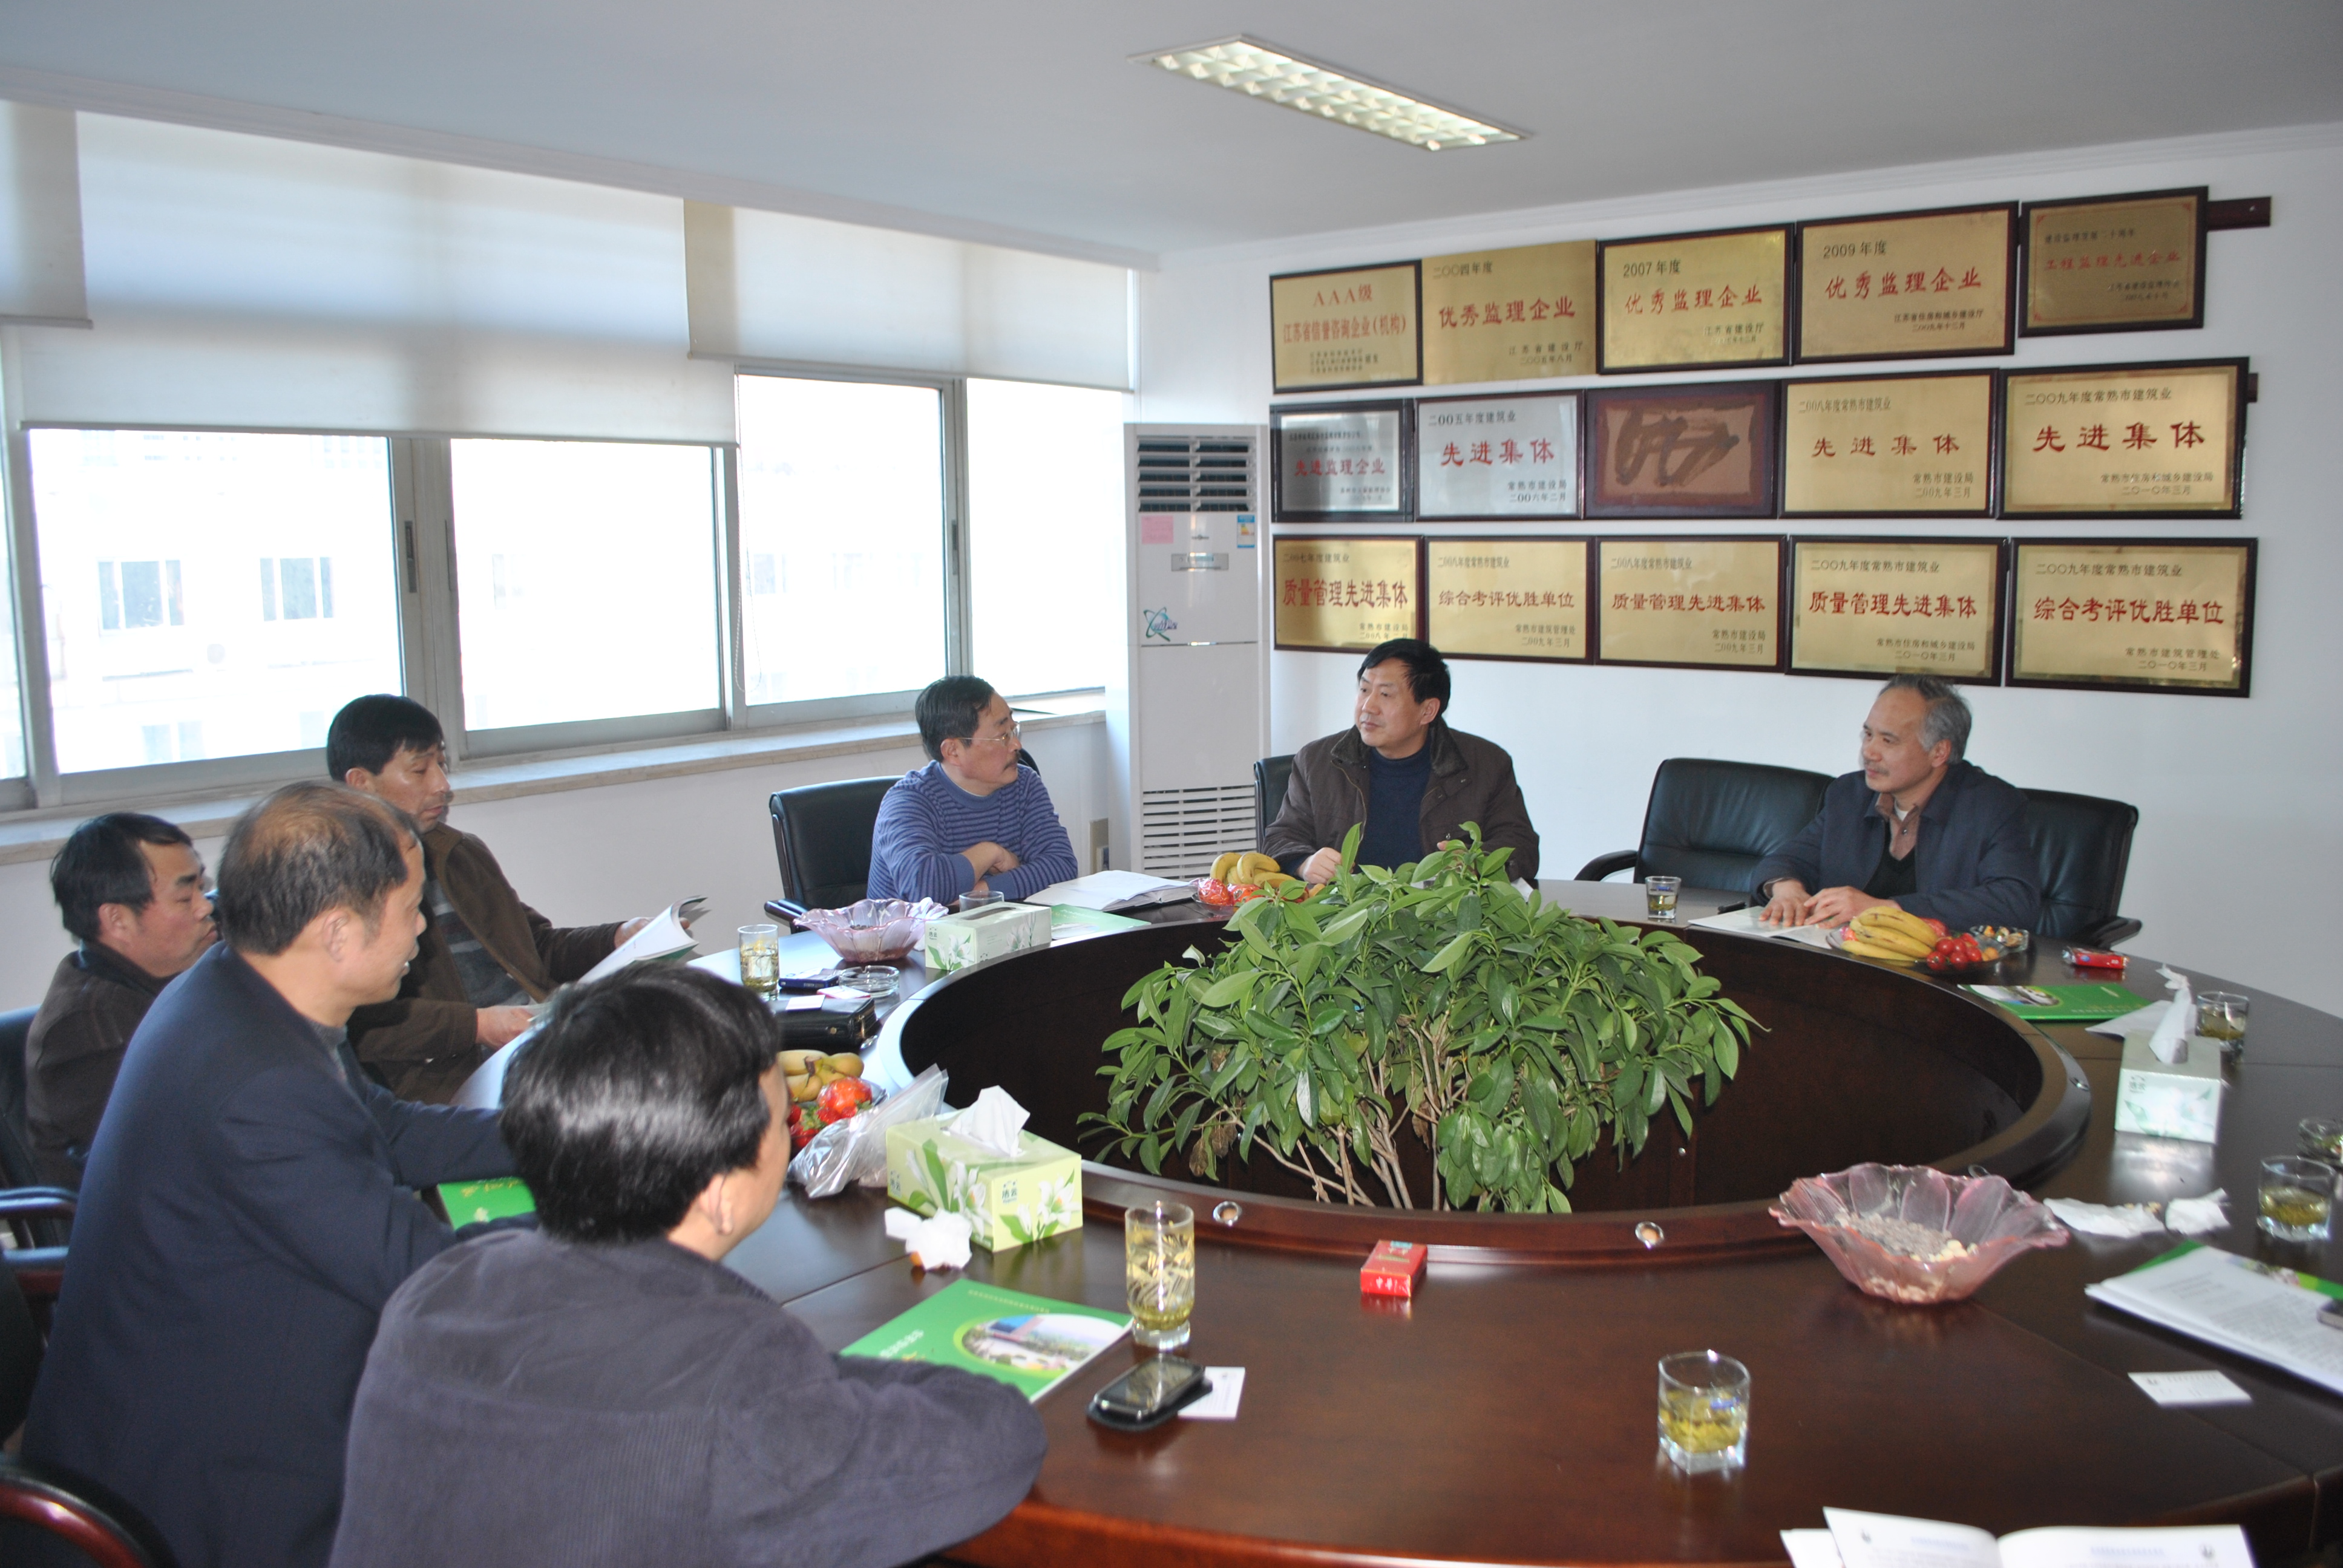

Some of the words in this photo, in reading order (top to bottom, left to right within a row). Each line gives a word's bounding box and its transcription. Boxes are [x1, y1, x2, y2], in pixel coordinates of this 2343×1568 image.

[1825, 266, 1982, 299] 优秀监理企业
[1625, 284, 1762, 315] 优秀监理企业
[1440, 296, 1576, 328] 优秀监理企业
[1509, 341, 1583, 355] 江苏省建设厅
[1812, 433, 1959, 458] 先进集体
[2033, 420, 2205, 452] 先进集体
[1441, 438, 1555, 467] 先进集体
[1295, 457, 1385, 477] 先进监理企业
[1508, 479, 1567, 490] 常熟市建设局
[1913, 472, 1974, 485] 常熟市建设局
[1283, 578, 1408, 609] 质量管理先进集体
[1439, 589, 1575, 608] 综合考评优胜单位
[1612, 593, 1766, 613] 质量管理先进集体
[1809, 590, 1977, 619] 质量管理先进集体
[2034, 596, 2224, 624] 综合考评优胜单位
[1712, 629, 1766, 641] 常熟市建设局
[1876, 638, 1975, 650] 常熟市住房和城乡建设局
[2125, 647, 2220, 659] 常熟市建筑管理处
